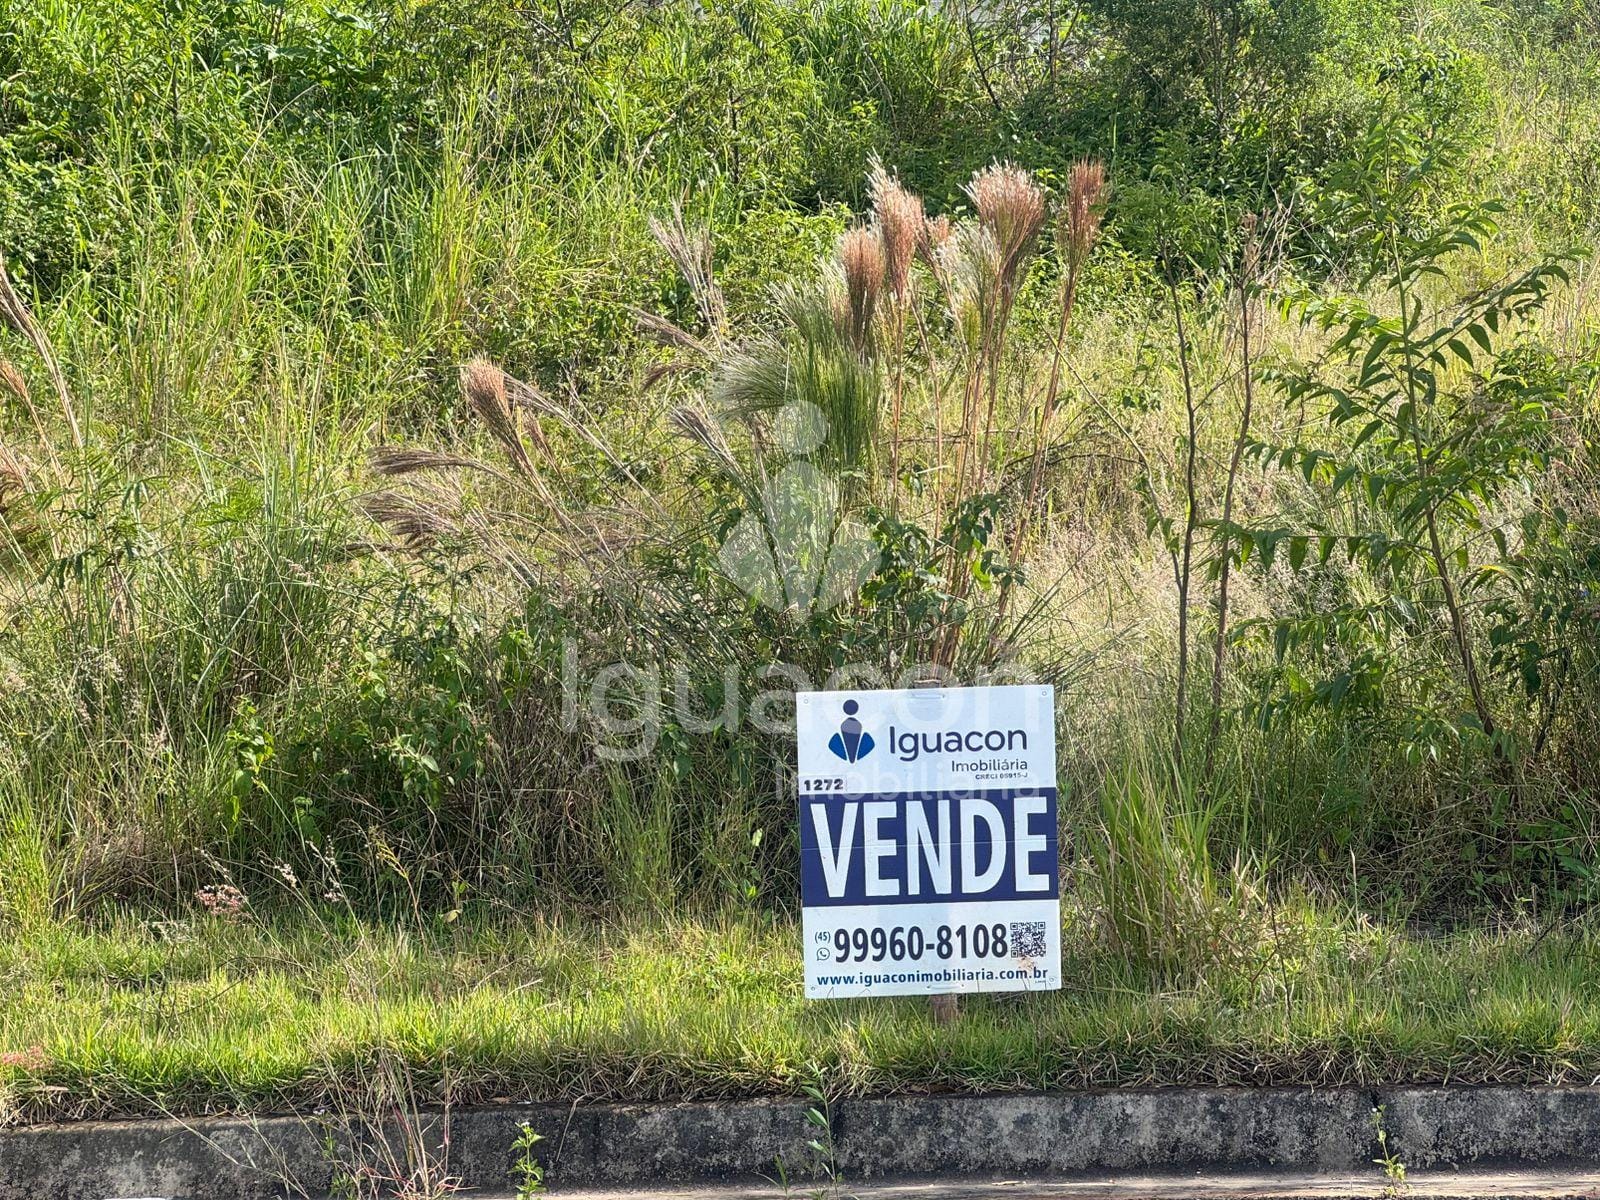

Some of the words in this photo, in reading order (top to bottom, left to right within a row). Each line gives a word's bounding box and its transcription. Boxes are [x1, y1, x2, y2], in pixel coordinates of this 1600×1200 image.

[889, 725, 1028, 762] Iguacon
[951, 759, 1028, 772] Imobiliária
[804, 778, 844, 791] 1272
[810, 797, 1050, 898] VENDE
[814, 931, 831, 944] (45)
[834, 923, 1008, 963] 99960-8108
[817, 967, 1049, 988] www.iguaconimobiliaria.com.br
